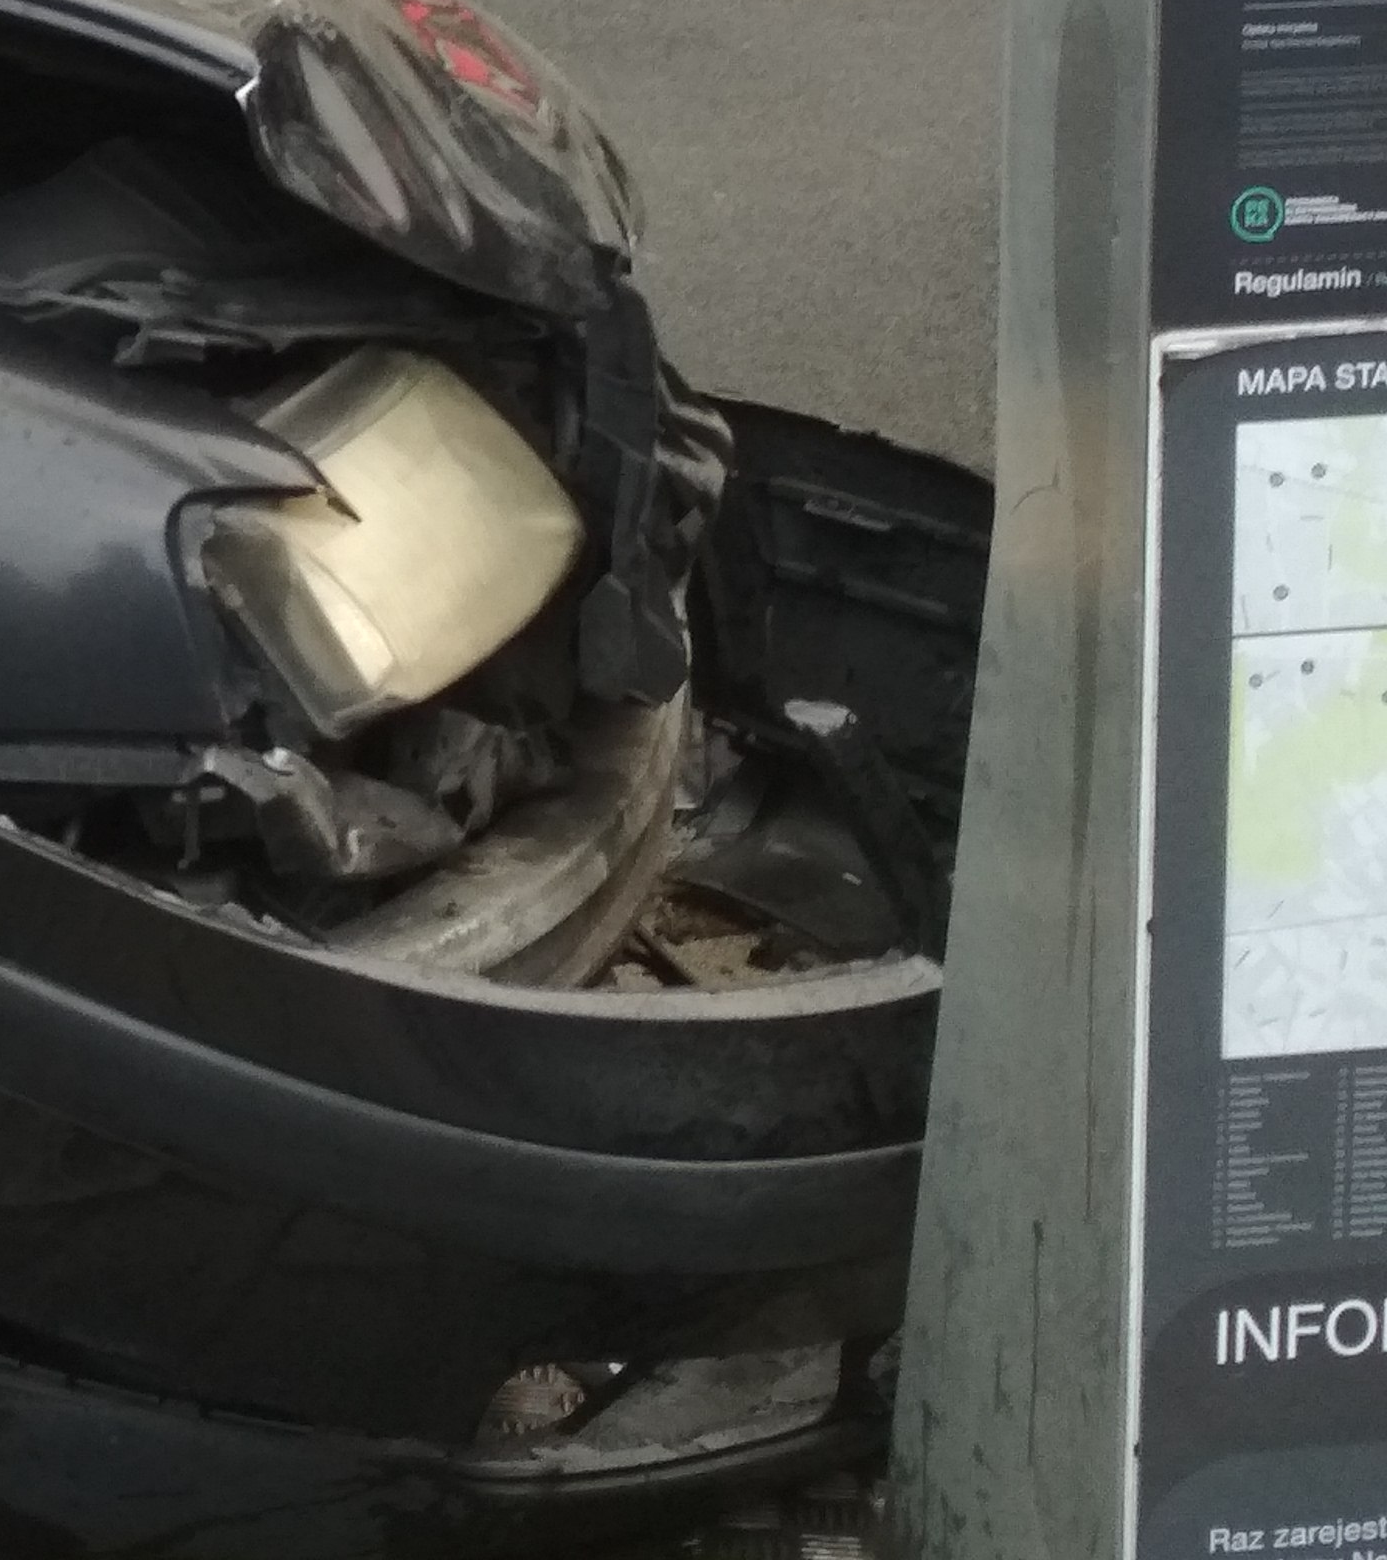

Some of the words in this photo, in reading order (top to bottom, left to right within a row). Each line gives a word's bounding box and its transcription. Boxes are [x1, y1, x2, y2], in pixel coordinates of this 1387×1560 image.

[1234, 265, 1362, 298] Regulamin
[1238, 364, 1326, 396] MAPA
[1216, 1298, 1387, 1365] INFO
[1209, 1527, 1265, 1554] Raz
